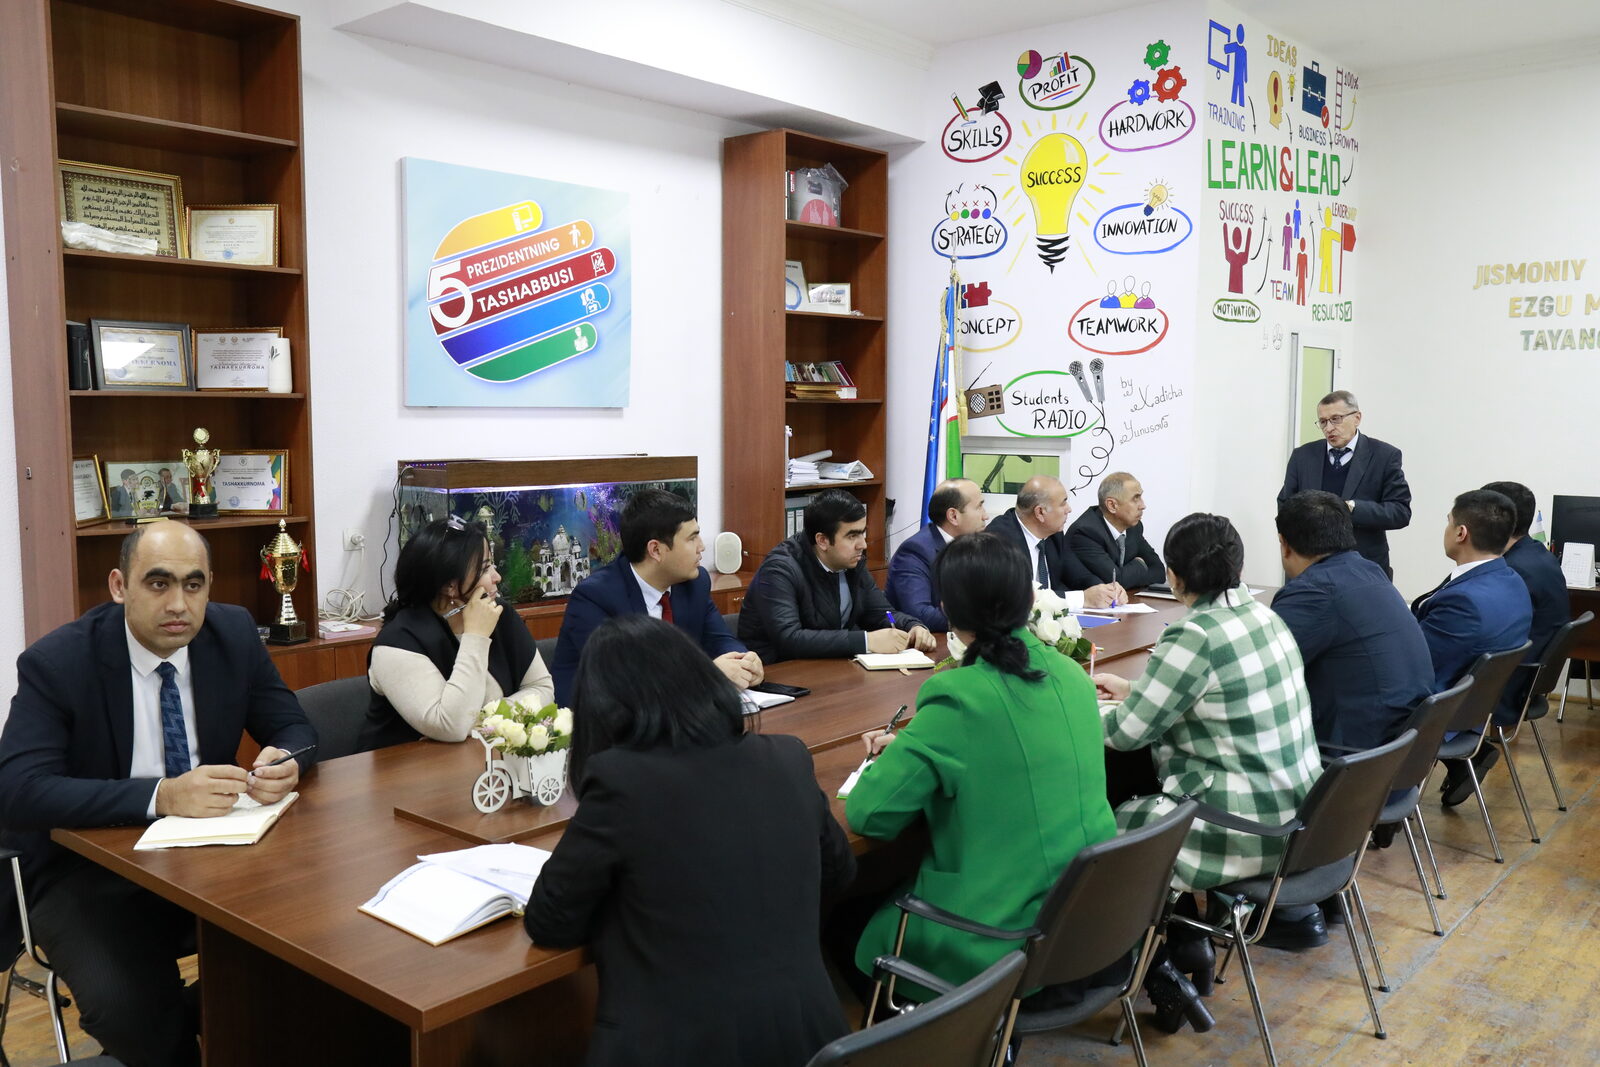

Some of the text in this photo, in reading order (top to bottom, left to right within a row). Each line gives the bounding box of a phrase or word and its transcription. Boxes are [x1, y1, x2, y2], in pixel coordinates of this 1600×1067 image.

[1266, 34, 1298, 68] IDEAS
[1030, 68, 1080, 100] PROFIT
[1108, 109, 1188, 138] HARDWORK
[1207, 102, 1246, 132] TRAINING
[948, 125, 1003, 152] SKILLS
[1298, 124, 1327, 146] BUSINESS
[1333, 132, 1359, 153] GROWTH
[1026, 166, 1082, 188] SUCCESS
[1219, 200, 1254, 225] SUCCESS
[938, 225, 1002, 250] STRATEGY
[1102, 217, 1178, 239] INNOVATION
[466, 237, 560, 280] PREZIDENTNING
[1472, 258, 1587, 290] JISMONIY
[428, 260, 474, 328] 5
[476, 267, 574, 313] TASHABBUSI
[1270, 279, 1294, 302] TEAM
[1312, 303, 1344, 321] RESULTS
[1508, 294, 1573, 318] EZGU
[957, 317, 1017, 335] ONCEPT
[1076, 317, 1159, 336] TEAMWORK
[1520, 327, 1600, 351] TAYAN
[1011, 387, 1069, 406] Students
[1120, 376, 1134, 397] by
[1031, 409, 1087, 430] RADIO
